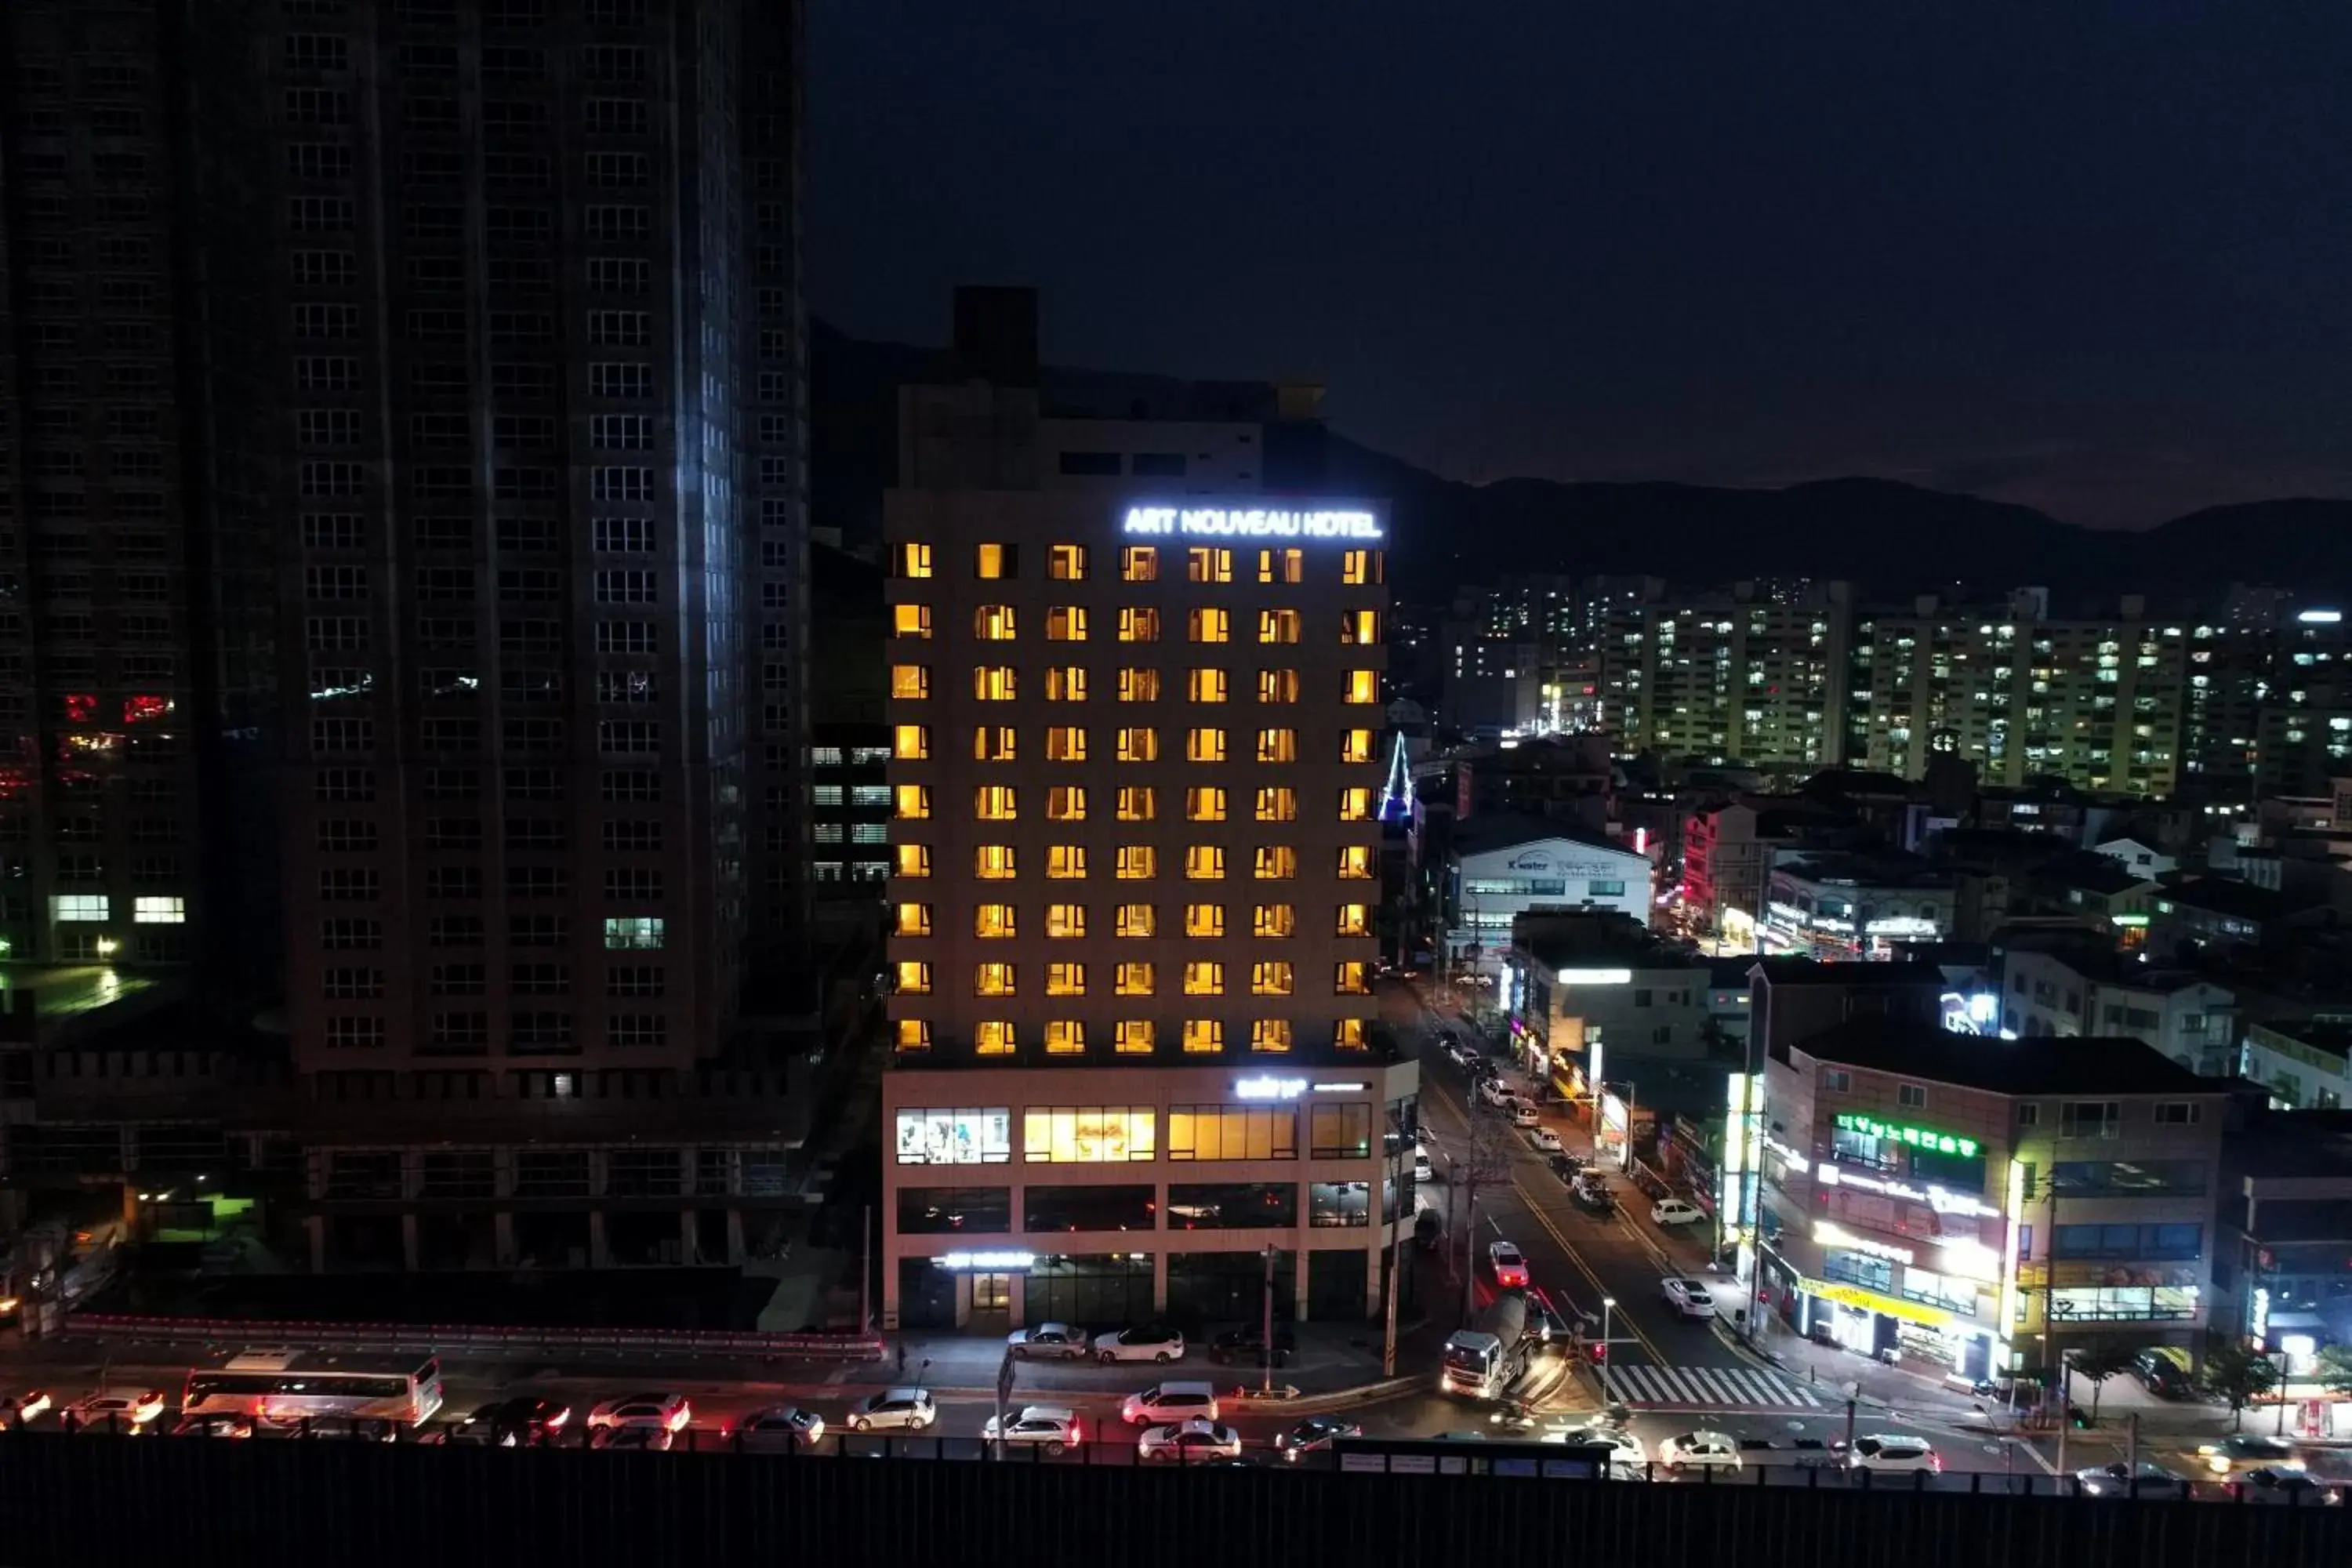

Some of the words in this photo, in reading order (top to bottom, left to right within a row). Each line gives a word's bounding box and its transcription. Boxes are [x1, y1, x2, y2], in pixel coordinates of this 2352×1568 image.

[1124, 508, 1178, 533] ART
[1181, 510, 1299, 535] NOUVEAU
[1304, 512, 1382, 537] HOTEL
